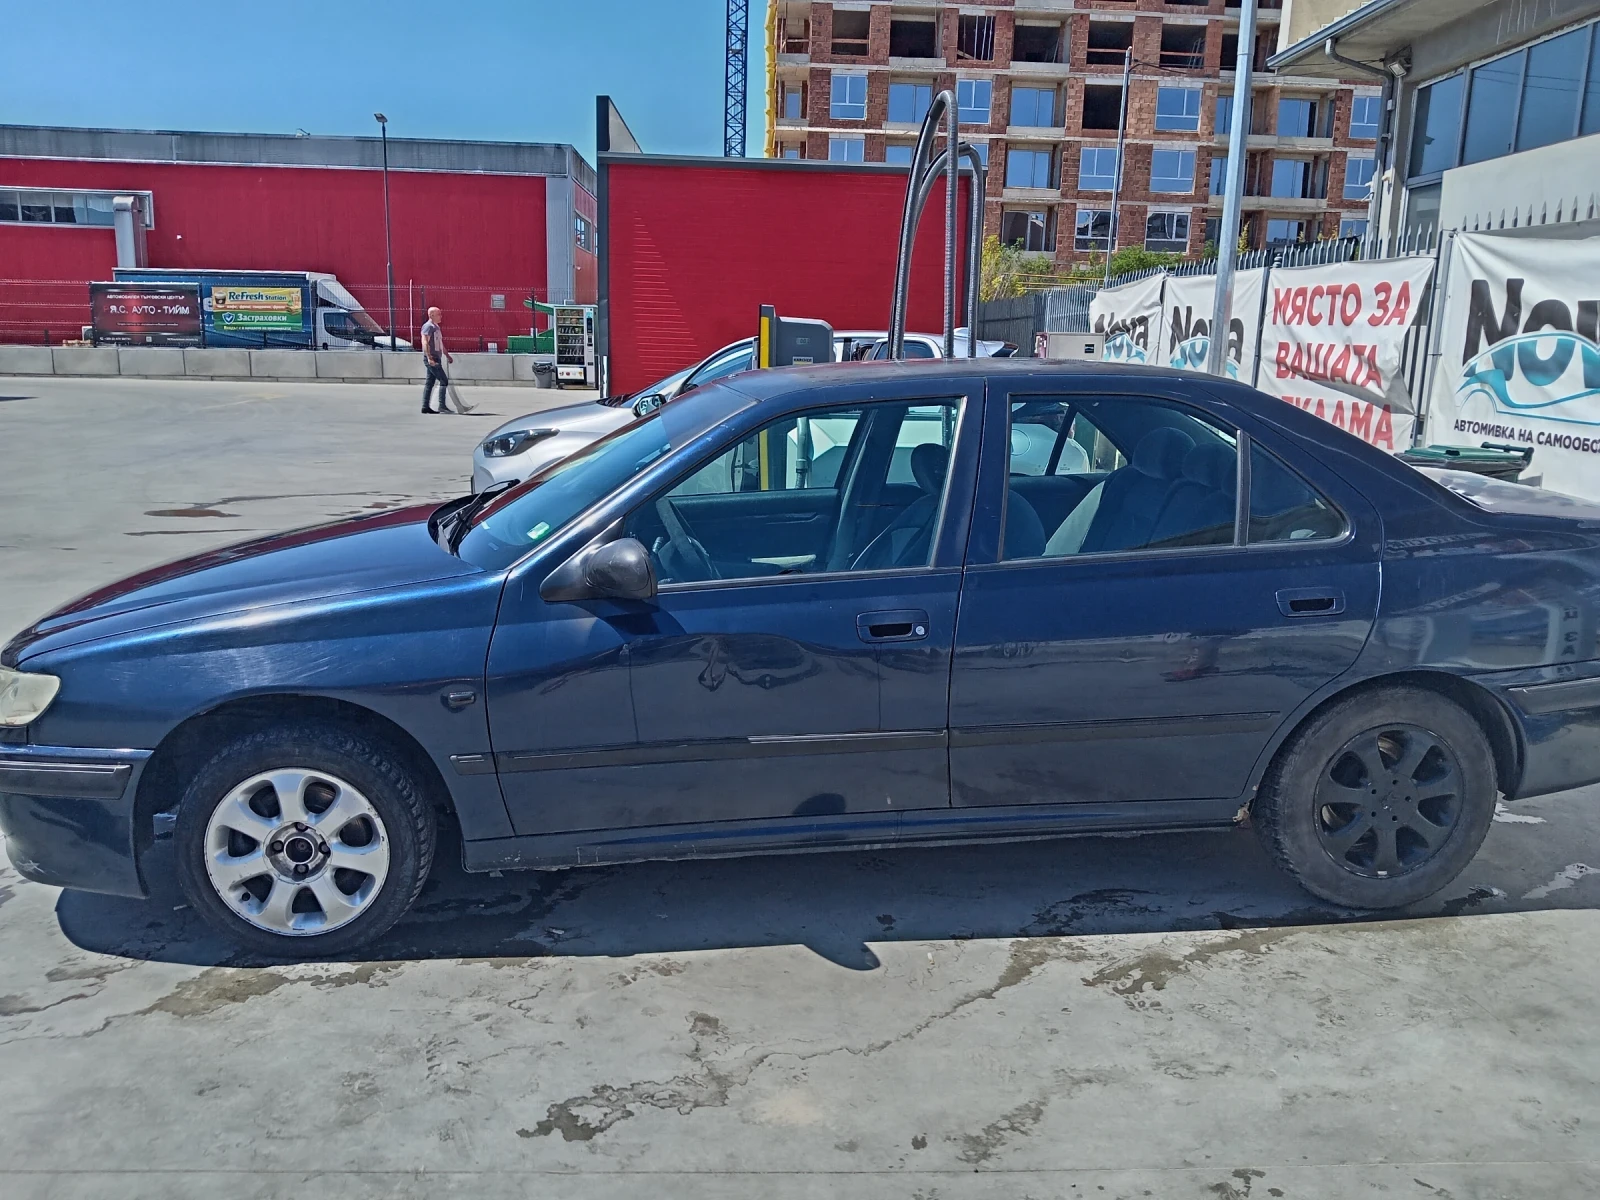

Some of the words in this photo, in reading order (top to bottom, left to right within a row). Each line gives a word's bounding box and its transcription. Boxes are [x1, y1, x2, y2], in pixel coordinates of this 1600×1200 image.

[132, 305, 156, 315] АУТО
[163, 304, 190, 315] ТИЙМ
[228, 291, 264, 301] ReFresh
[1272, 283, 1362, 327] МЯСТО
[1367, 281, 1411, 327] ЗА
[237, 313, 287, 322] Застраховки
[1170, 306, 1244, 366] Noa
[1276, 342, 1382, 388] ВАШАТА
[1274, 395, 1394, 450] ЛАМА
[1454, 419, 1515, 441] АВТОМИВКА
[1518, 429, 1534, 443] НА
